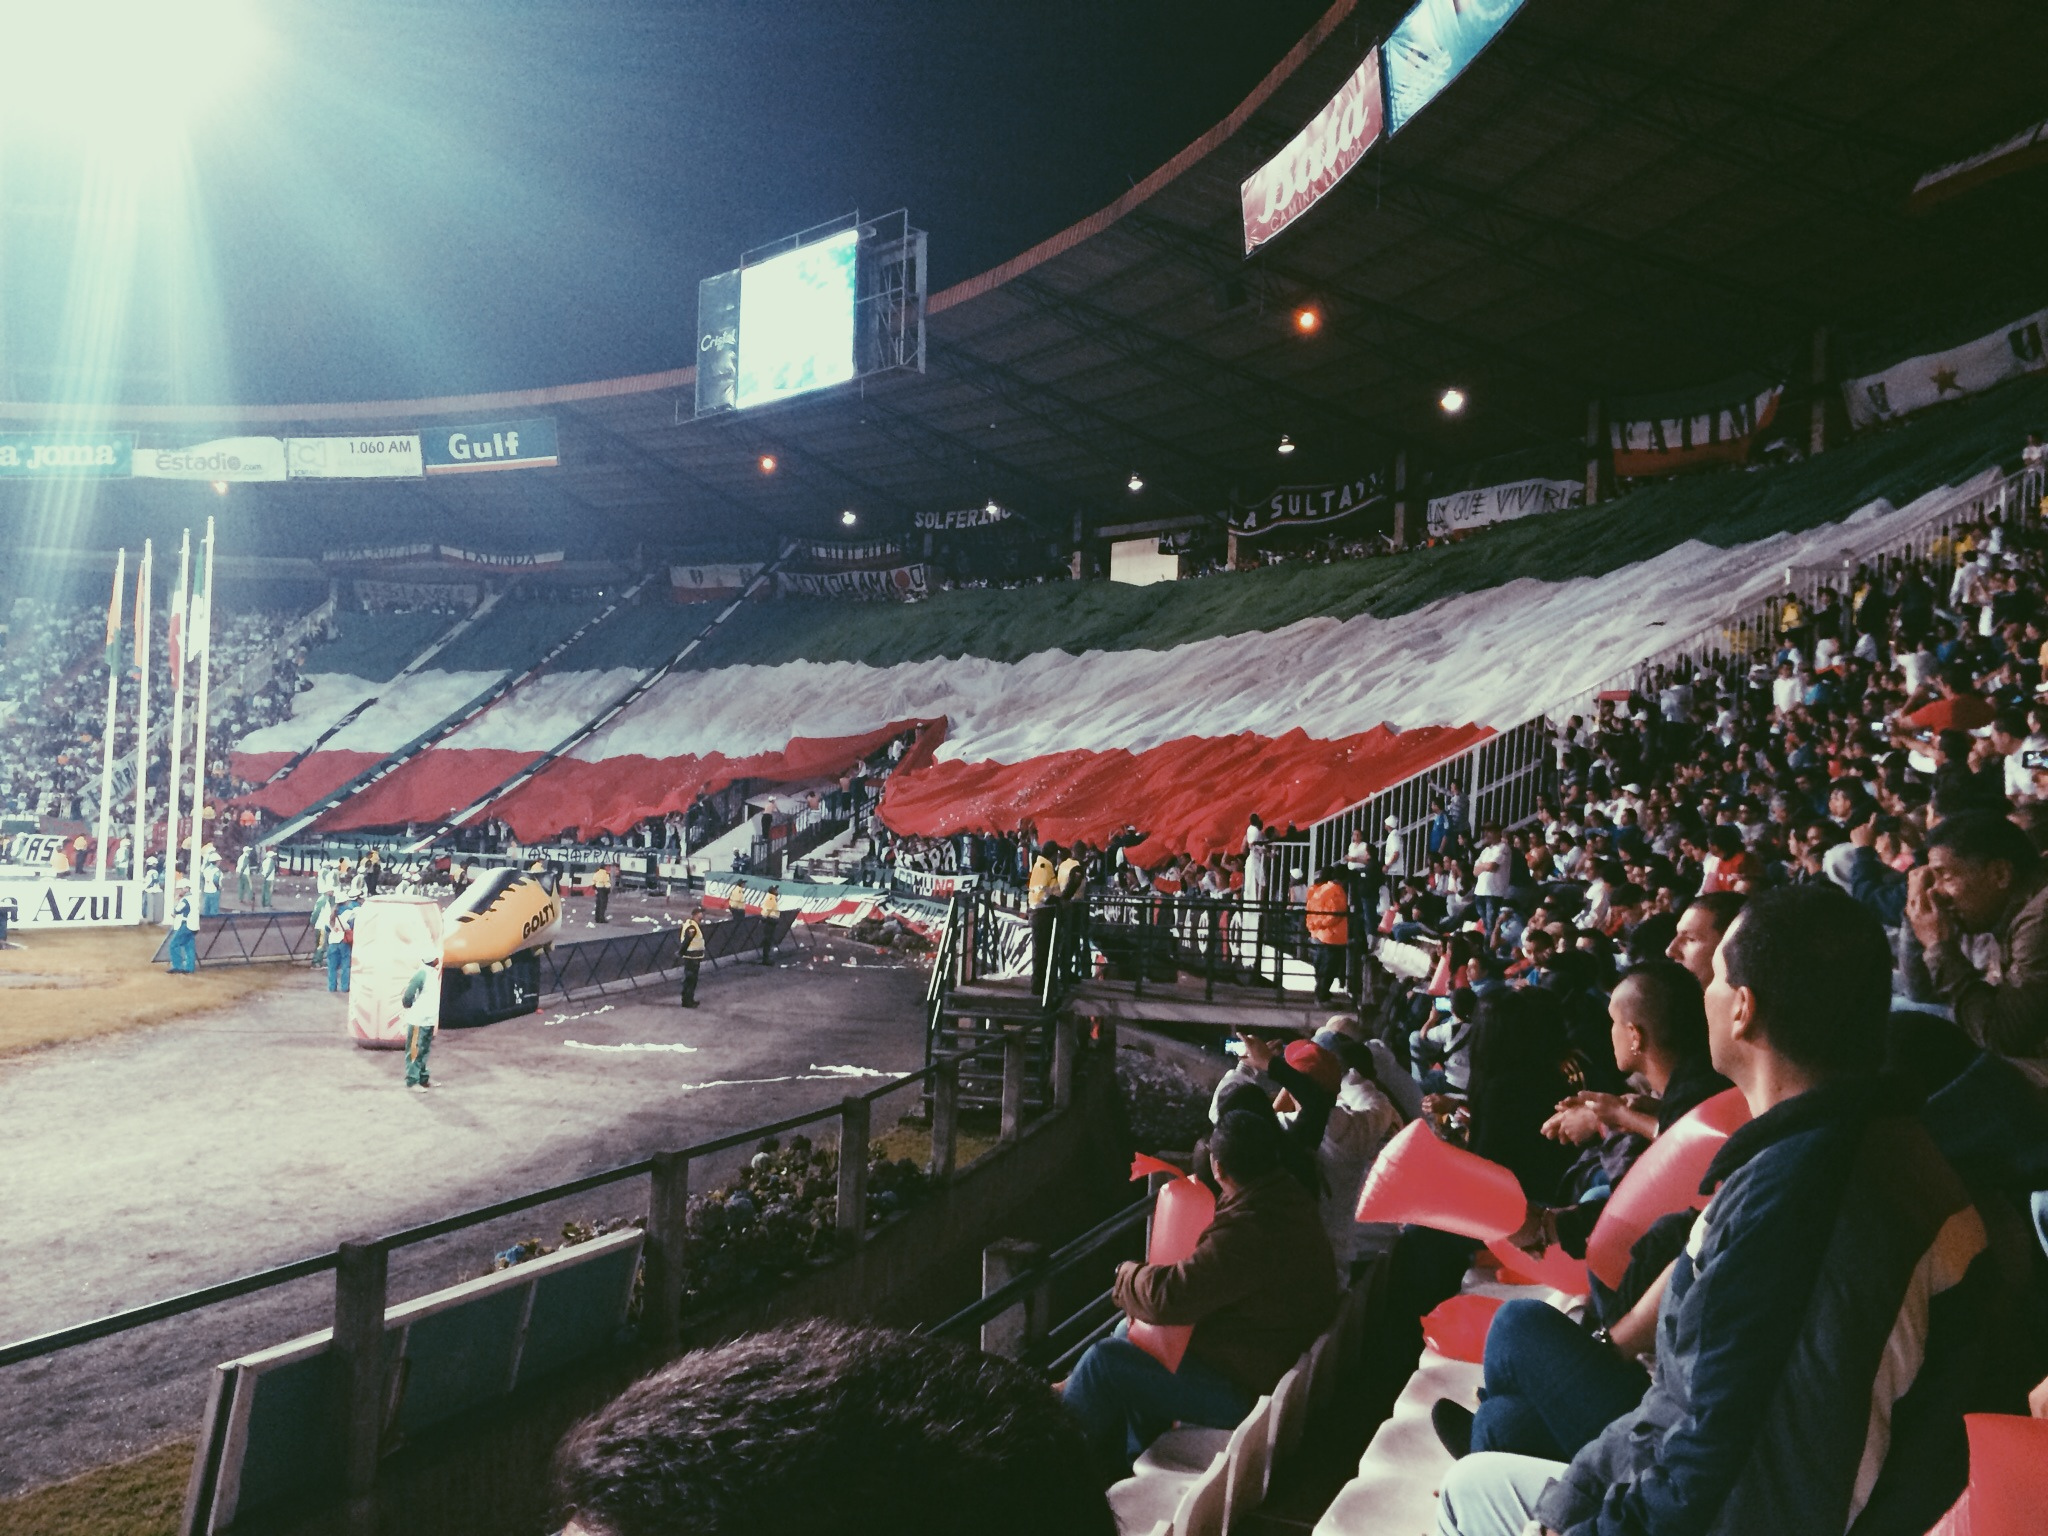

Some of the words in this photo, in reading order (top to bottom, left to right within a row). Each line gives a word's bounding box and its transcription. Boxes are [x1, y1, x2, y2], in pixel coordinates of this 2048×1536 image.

[1339, 141, 1363, 170] VIDA
[350, 441, 384, 454] 1.060
[388, 440, 411, 453] AM
[449, 431, 519, 460] Gulf
[898, 869, 954, 897] COMUNA
[33, 886, 124, 921] Azul
[523, 901, 556, 939] GOLTY
